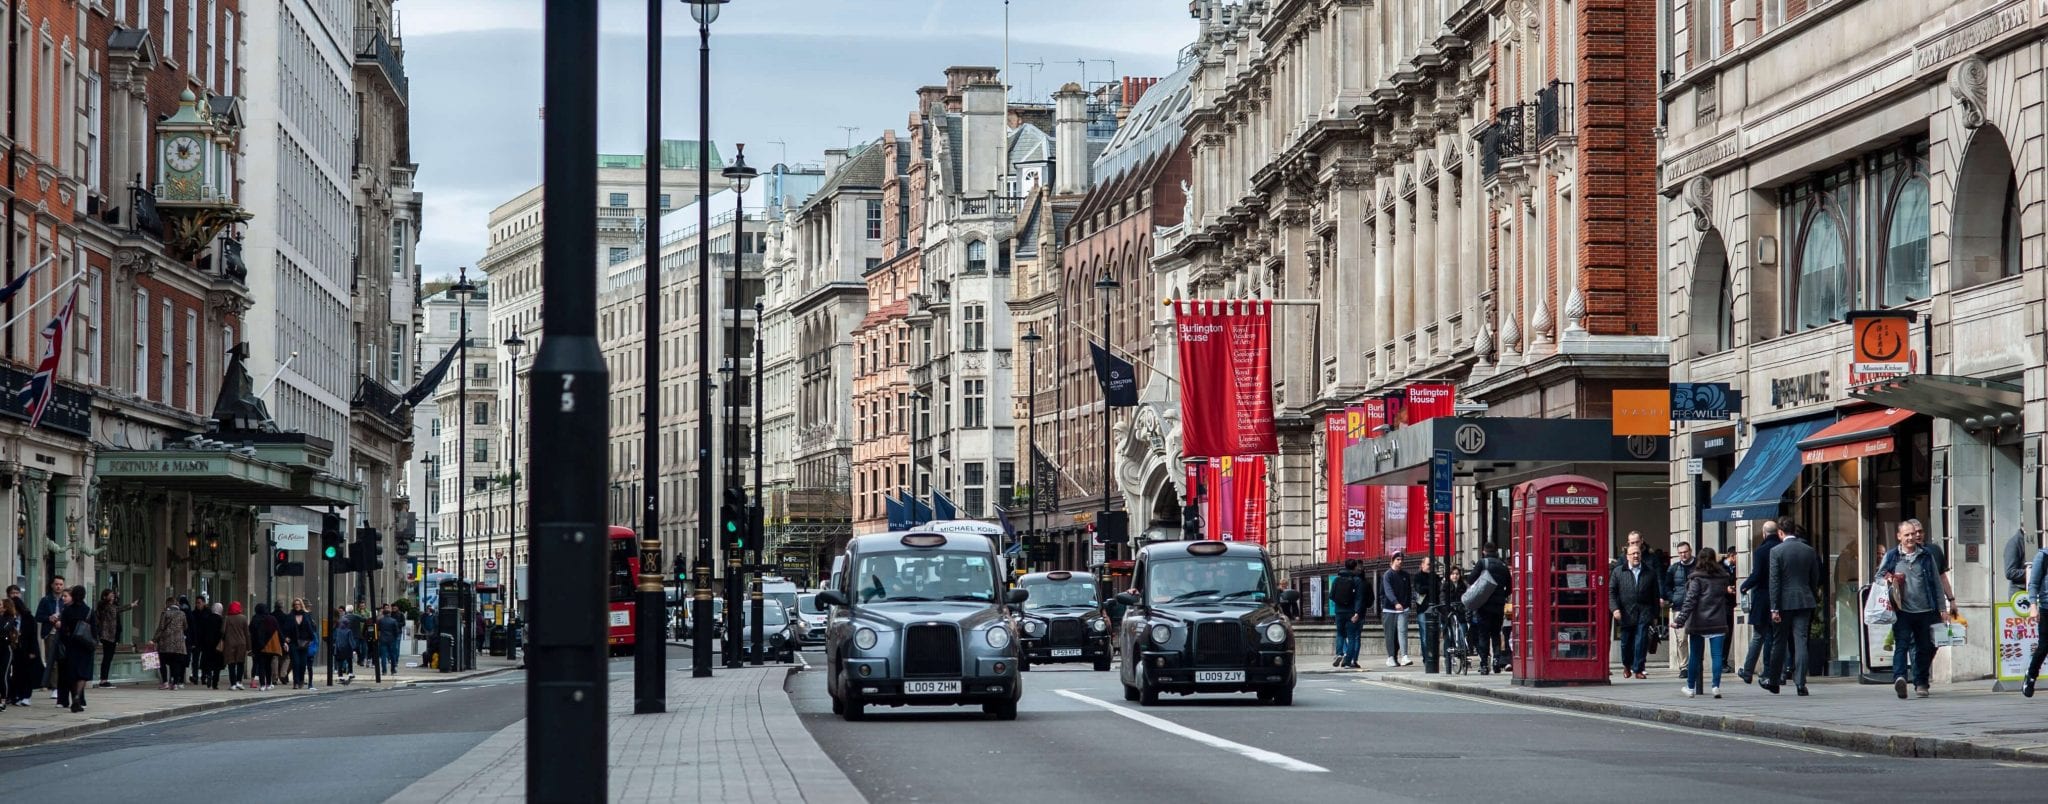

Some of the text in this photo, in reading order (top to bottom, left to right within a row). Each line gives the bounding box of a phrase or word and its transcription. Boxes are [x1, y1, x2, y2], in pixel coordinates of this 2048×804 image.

[1180, 324, 1223, 334] Burlington
[1180, 333, 1208, 342] House
[1410, 388, 1449, 397] Burlington
[1672, 409, 1729, 418] FREYWILLE
[1459, 426, 1483, 450] MG
[110, 461, 209, 472] FORTNUM & MASON
[1224, 672, 1241, 681] ZJY
[937, 682, 957, 692] ZHM
